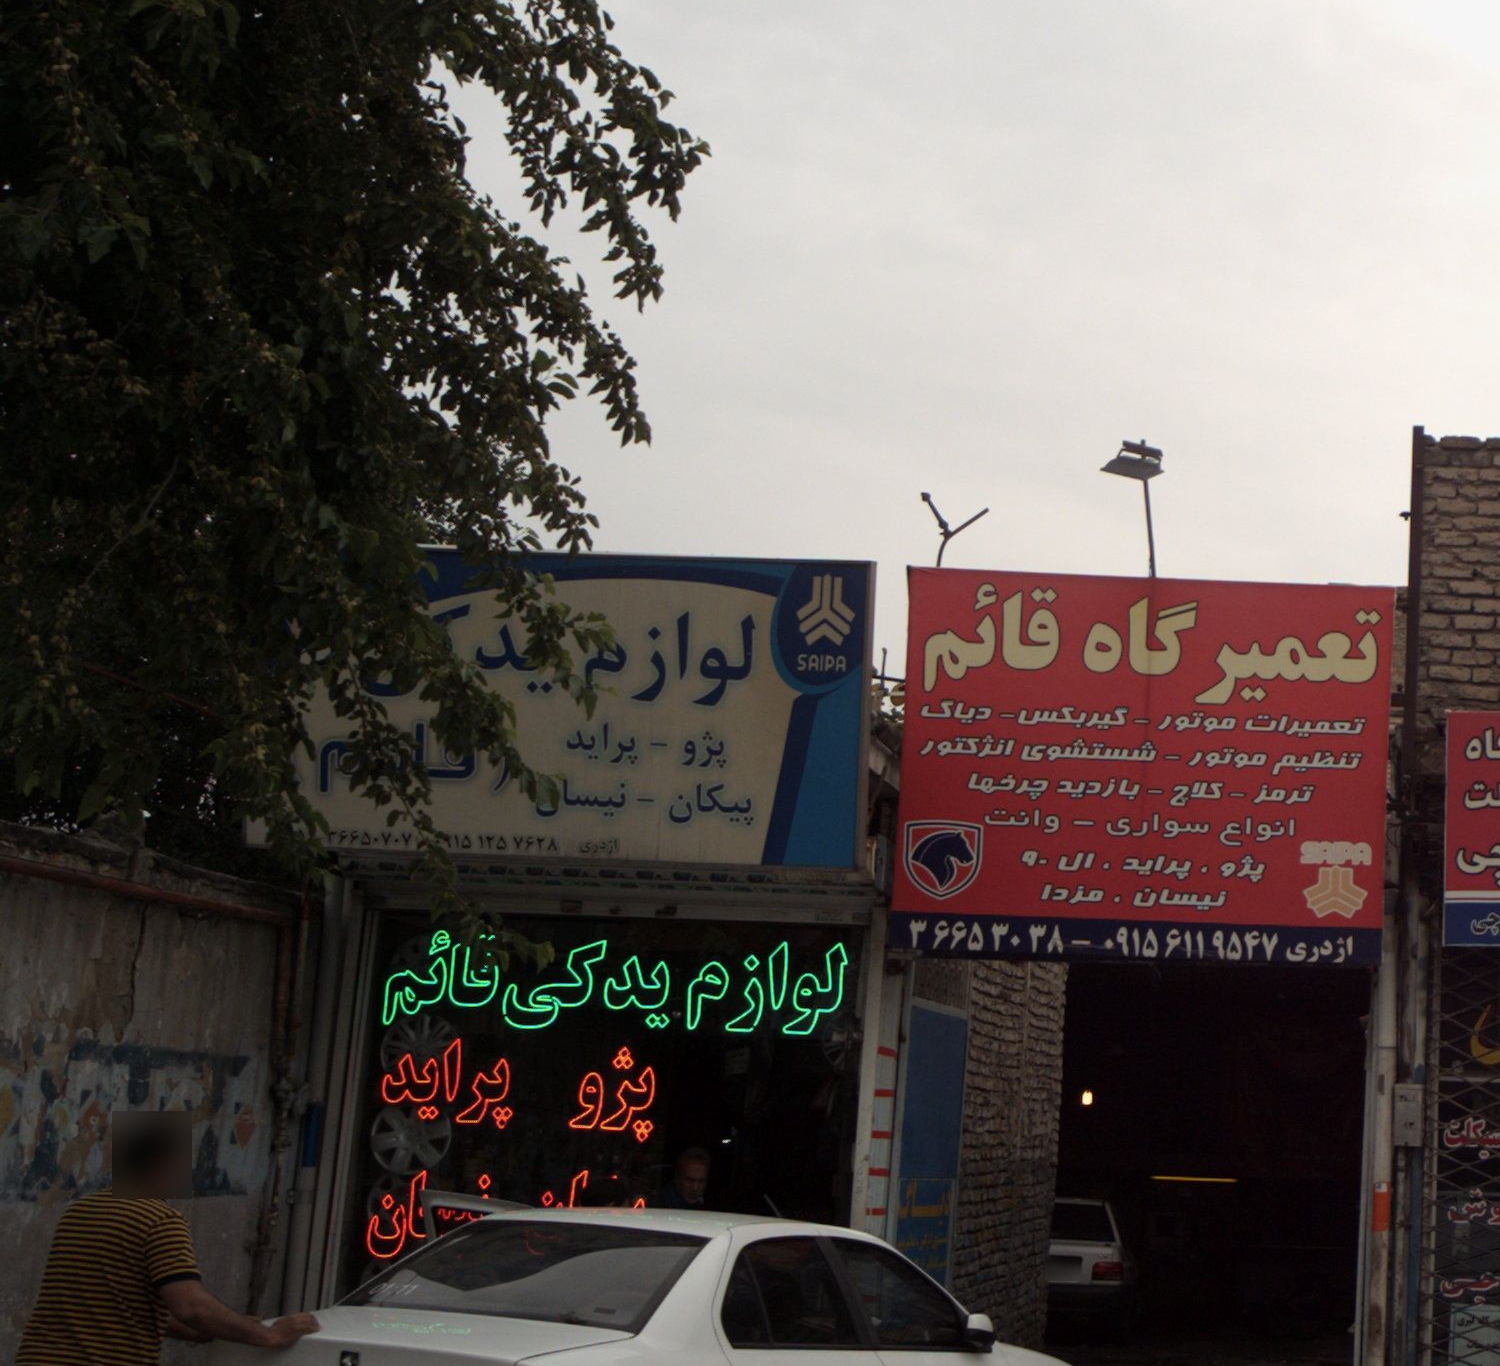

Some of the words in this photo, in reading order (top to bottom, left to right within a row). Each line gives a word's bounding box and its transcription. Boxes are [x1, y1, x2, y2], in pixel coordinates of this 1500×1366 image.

[922, 582, 1062, 693] قائم
[1082, 596, 1198, 676] گاه
[796, 653, 848, 673] SAIPA
[1195, 608, 1383, 705] تعمیر
[1017, 706, 1129, 730] گیربکس
[1157, 711, 1238, 732] موتور
[1245, 715, 1367, 737] تعمیرات
[566, 722, 639, 765] پراید
[681, 731, 728, 769] پژو
[919, 734, 1016, 758] انژکتور
[1020, 738, 1157, 762] شستشوی
[1188, 746, 1268, 769] موتور
[1272, 750, 1363, 775] تنظیم
[967, 772, 1050, 800] چرخها
[1056, 777, 1141, 800] بازدید
[1169, 780, 1224, 807] کلاچ
[1253, 784, 1315, 806] ترمز
[668, 783, 755, 826] پیکان
[983, 808, 1061, 834] وانت
[1105, 812, 1210, 838] سواری
[1219, 816, 1296, 846] انواع
[1057, 851, 1096, 872] ال
[1122, 854, 1193, 880] پراید
[1220, 855, 1266, 883] پژو
[1040, 883, 1105, 906] مزدا
[1132, 887, 1228, 912] نیسان
[381, 929, 500, 1026] قائم
[502, 939, 671, 1030] یدکی
[686, 940, 848, 1035] لوازم
[380, 1038, 514, 1129] پراید
[568, 1045, 657, 1143] پژو
